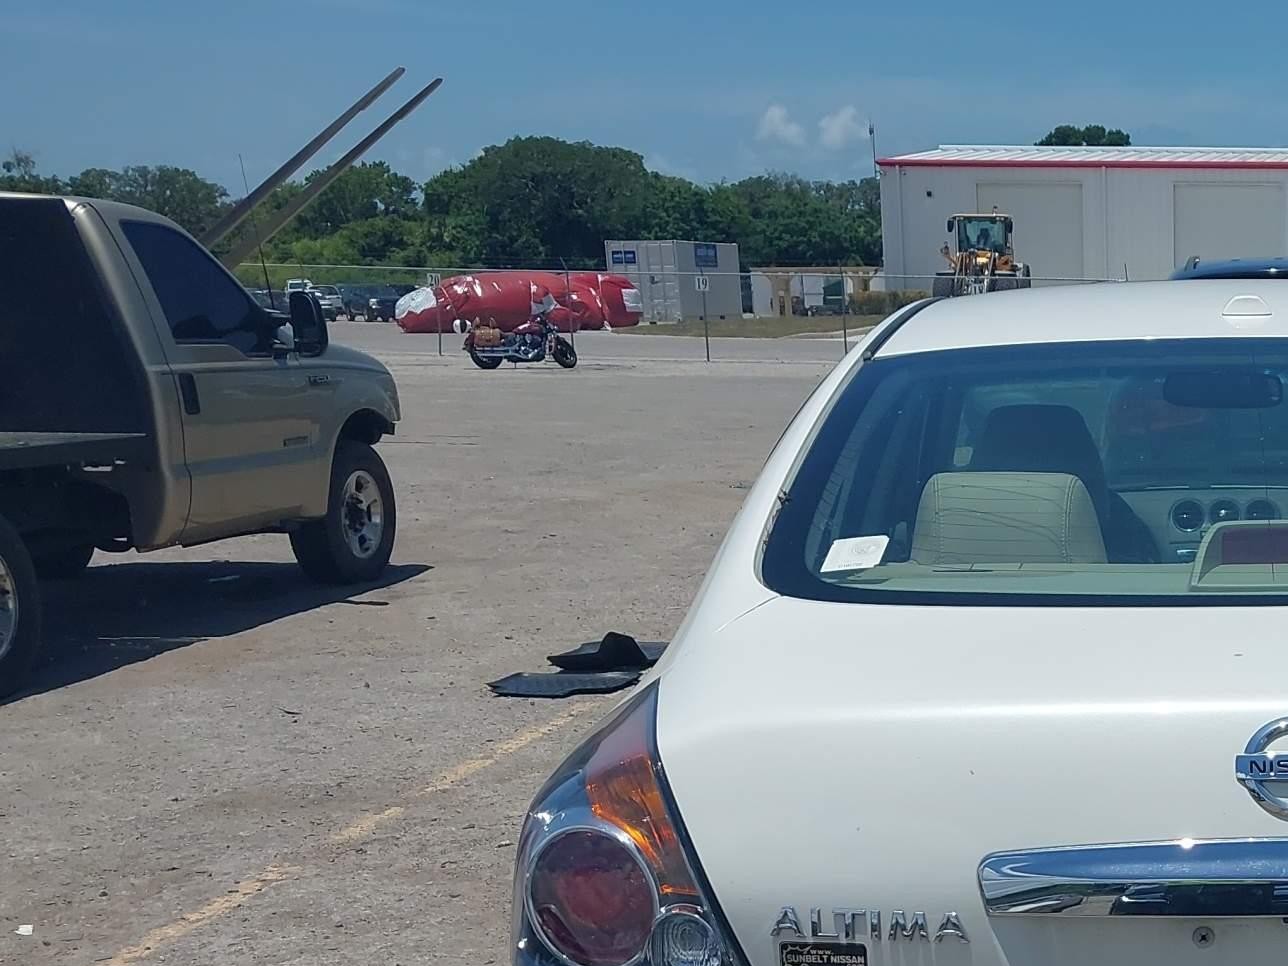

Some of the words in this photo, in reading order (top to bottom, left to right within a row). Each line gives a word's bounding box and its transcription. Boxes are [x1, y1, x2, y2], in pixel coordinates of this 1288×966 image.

[428, 274, 440, 286] 20
[696, 277, 708, 289] 19
[770, 906, 971, 944] ALTIMA
[786, 953, 828, 964] SUNBELT
[830, 955, 865, 964] NISSAN
